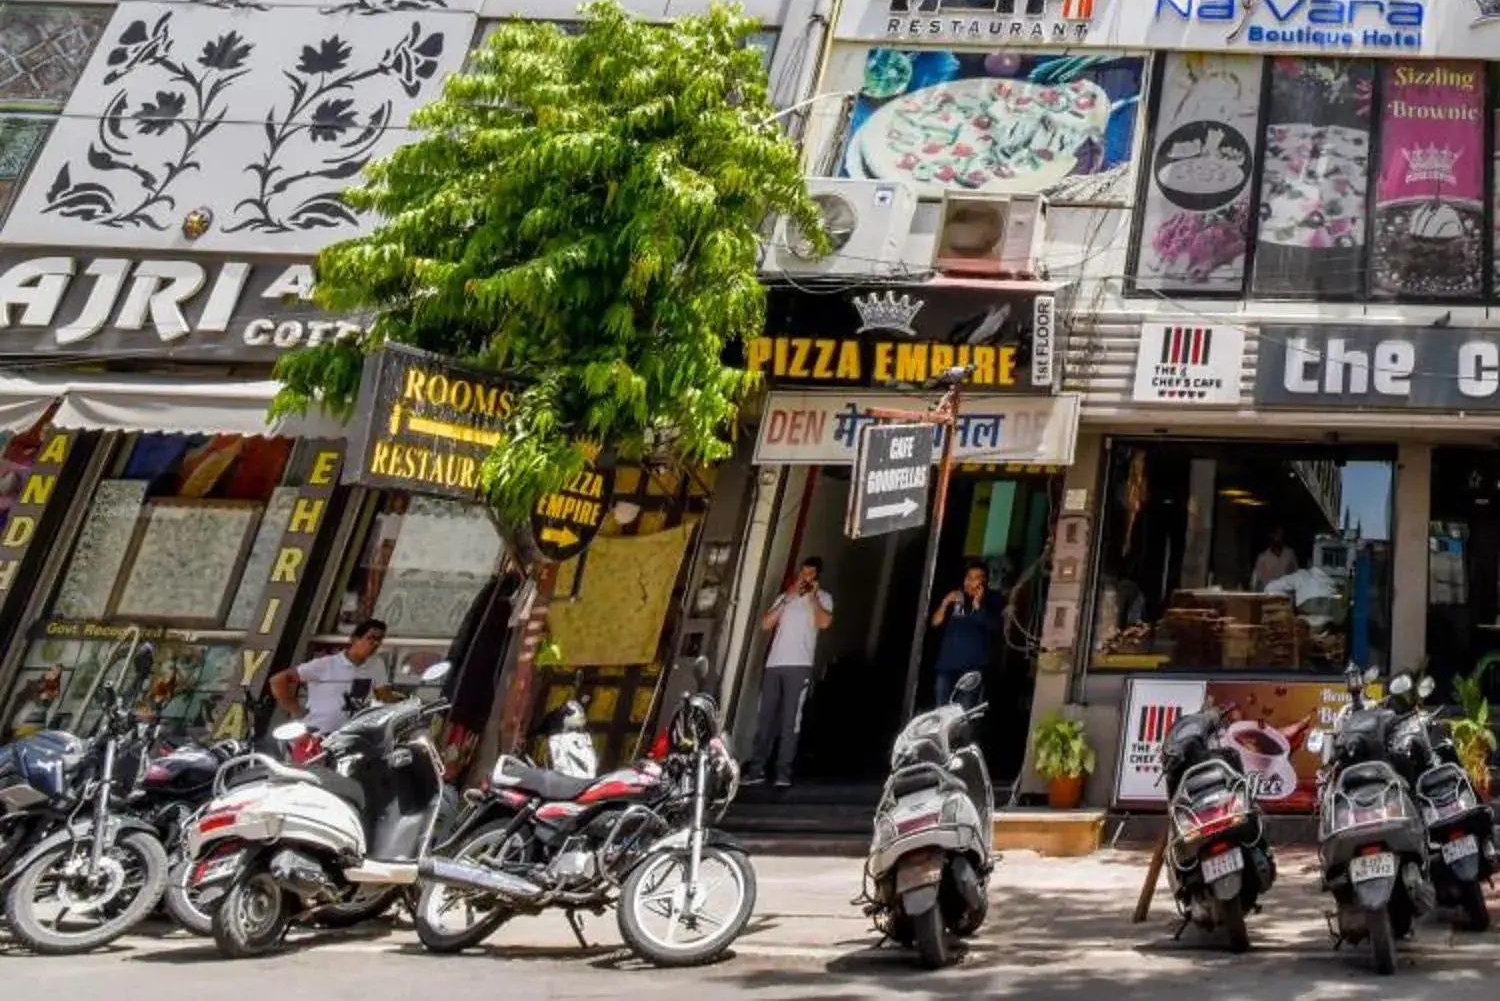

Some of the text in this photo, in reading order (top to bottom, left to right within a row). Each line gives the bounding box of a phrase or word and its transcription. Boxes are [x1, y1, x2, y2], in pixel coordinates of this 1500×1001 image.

[887, 18, 1089, 38] RESTAURANT
[1248, 25, 1423, 48] Boutique Hotel
[1395, 66, 1473, 91] Sizzling
[1392, 100, 1479, 120] Brownie
[1037, 302, 1050, 383] 1st FLOOR
[749, 337, 1018, 386] PIZZA EMPIRE
[1154, 365, 1176, 376] THE
[404, 367, 514, 420] ROOMS
[537, 492, 603, 527] EMPIRE
